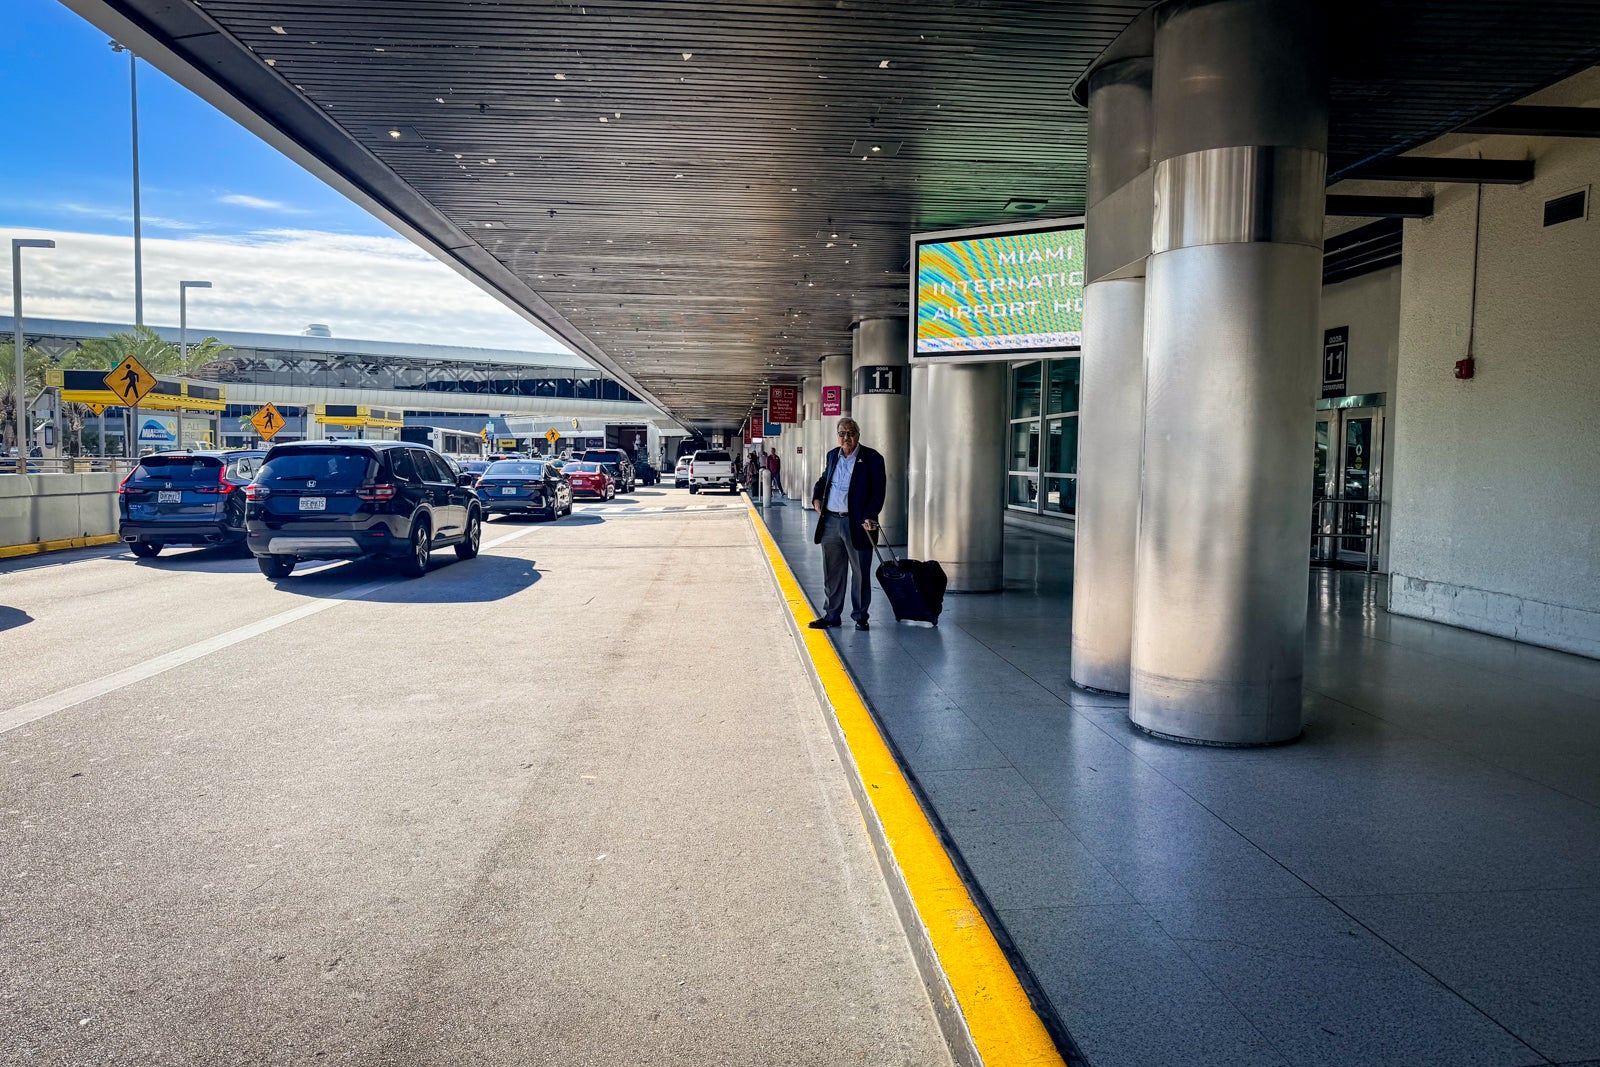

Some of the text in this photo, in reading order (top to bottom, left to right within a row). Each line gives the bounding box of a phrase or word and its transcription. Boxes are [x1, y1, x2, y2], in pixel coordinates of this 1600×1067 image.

[998, 246, 1073, 265] MIAMI
[932, 301, 1040, 321] AIRPORT
[1328, 335, 1342, 344] DOOR
[1327, 351, 1343, 375] 11
[872, 371, 893, 389] 11
